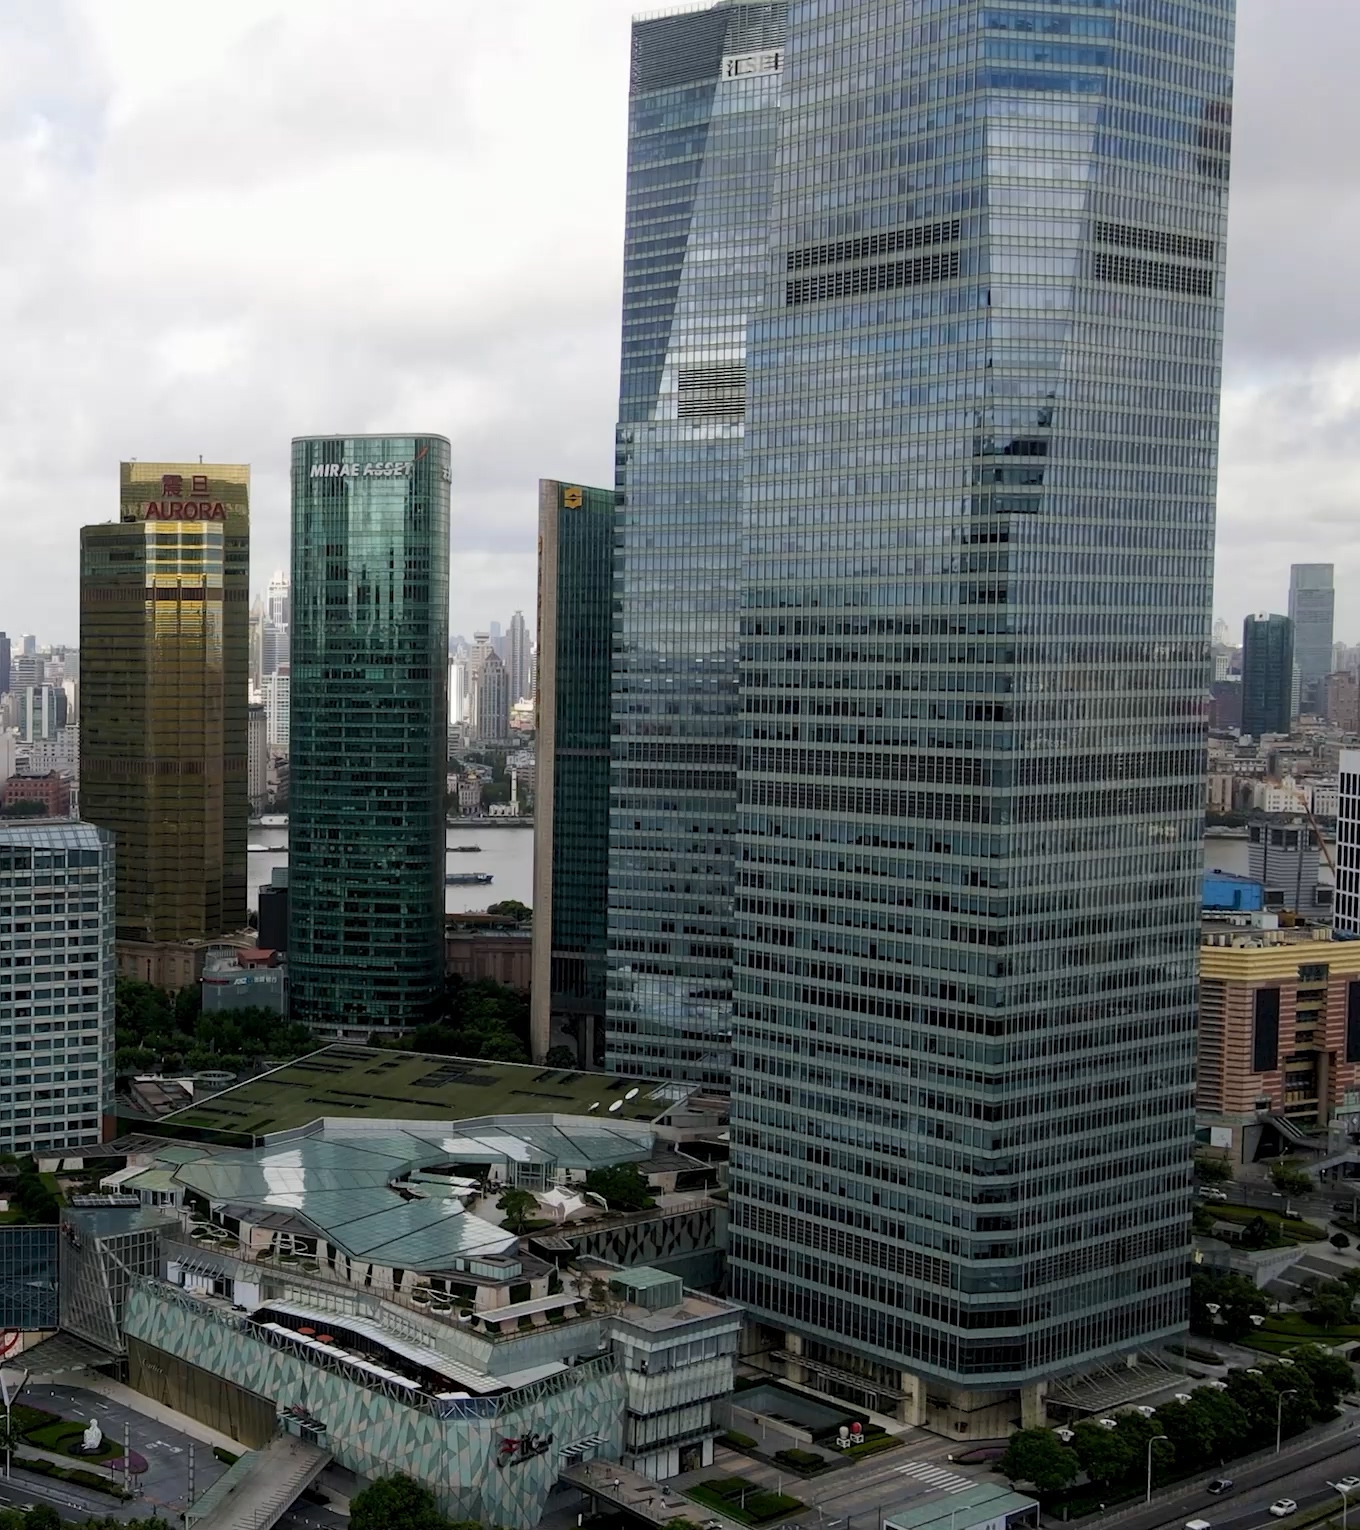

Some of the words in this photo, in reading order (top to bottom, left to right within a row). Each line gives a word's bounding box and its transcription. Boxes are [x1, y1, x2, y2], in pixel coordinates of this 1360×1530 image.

[309, 463, 360, 478] MIRAE
[362, 461, 413, 477] ASSET
[161, 474, 210, 497] 震旦
[144, 501, 227, 521] AURORA
